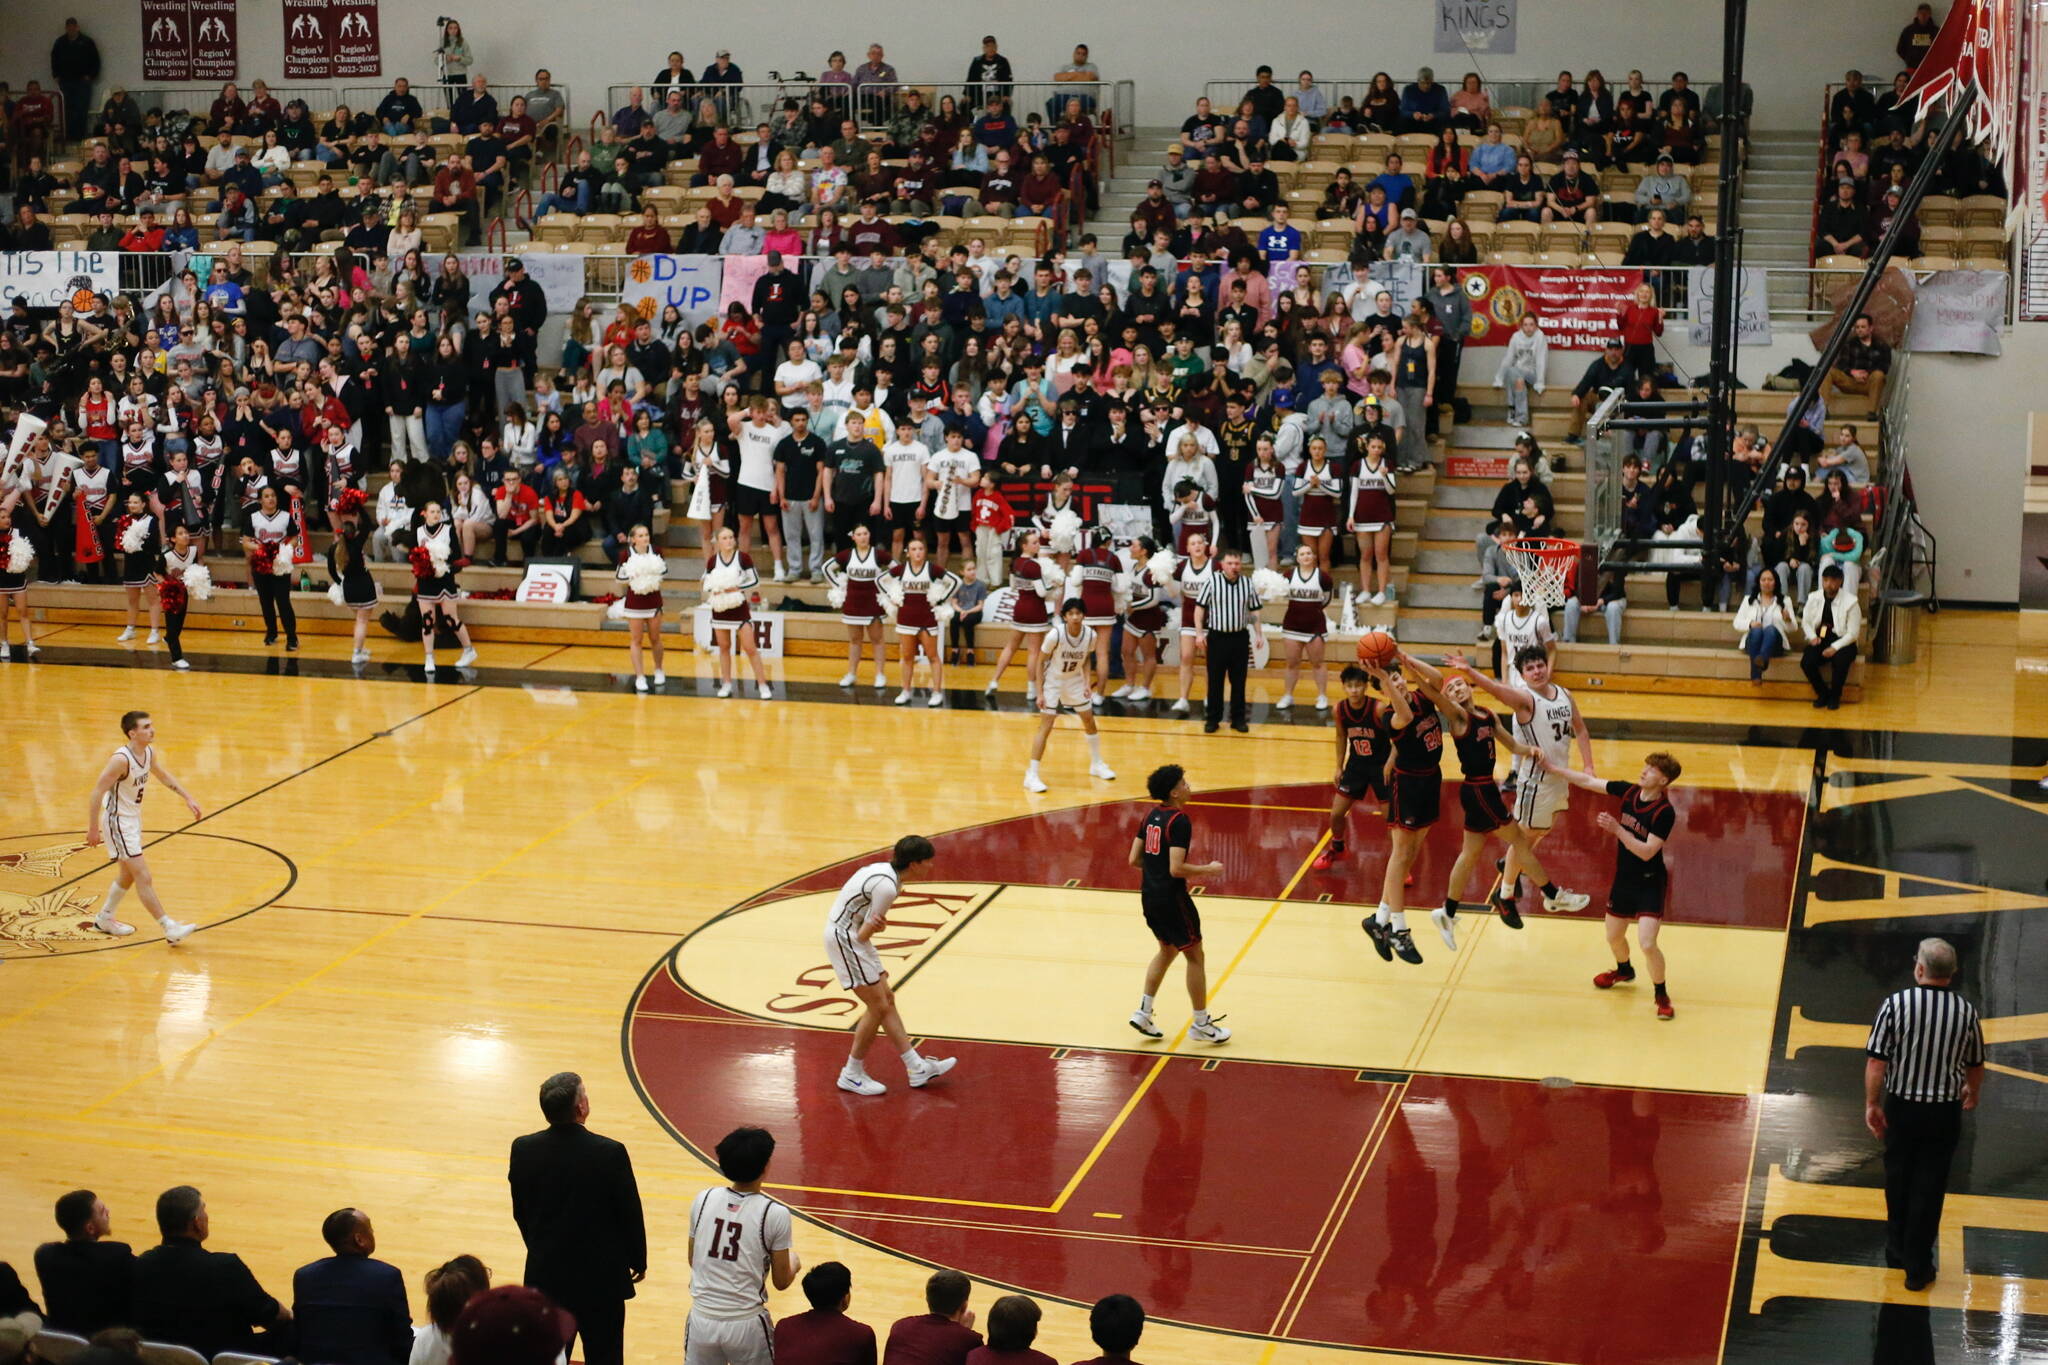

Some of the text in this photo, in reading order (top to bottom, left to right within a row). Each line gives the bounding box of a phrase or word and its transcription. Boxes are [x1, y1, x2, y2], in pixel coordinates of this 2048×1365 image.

[143, 0, 187, 12] Wrestling
[191, 1, 235, 12] Wrestling
[1442, 4, 1510, 31] KINGS
[192, 58, 236, 68] Champions
[285, 54, 330, 65] Champions
[334, 53, 379, 65] Champions
[654, 254, 698, 281] D-
[666, 285, 711, 310] UP
[1538, 317, 1560, 329] Go
[1562, 317, 1606, 332] Kings
[1508, 634, 1529, 644] KINGS
[1061, 650, 1084, 659] KINGS
[1062, 661, 1077, 672] 12
[1546, 705, 1571, 721] KINGS
[1551, 722, 1571, 742] 34
[1353, 739, 1373, 756] 12
[135, 787, 145, 804] 5
[1145, 823, 1161, 855] 10
[707, 1217, 743, 1262] 13
